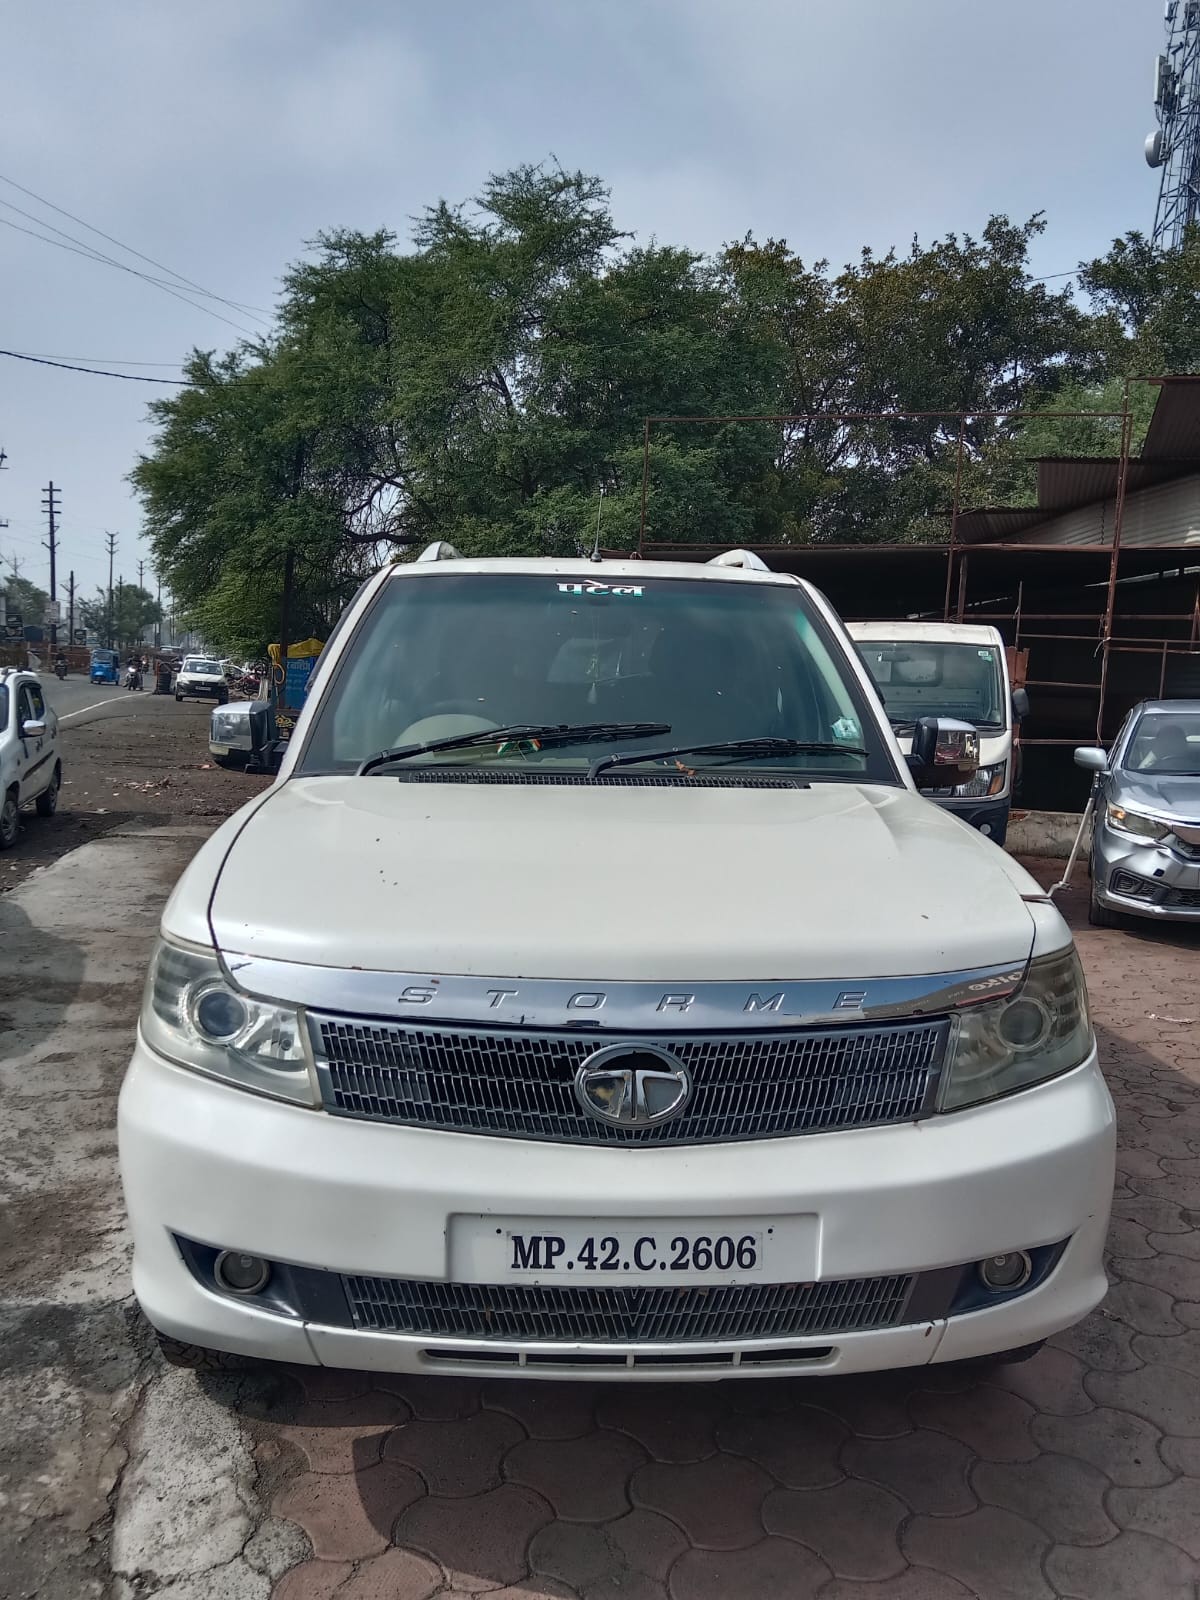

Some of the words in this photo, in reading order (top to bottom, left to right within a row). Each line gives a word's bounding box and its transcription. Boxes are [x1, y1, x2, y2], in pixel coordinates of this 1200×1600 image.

[556, 578, 646, 597] पटेल
[398, 986, 868, 1013] STORME
[511, 1235, 757, 1271] MP.42.C.2606
